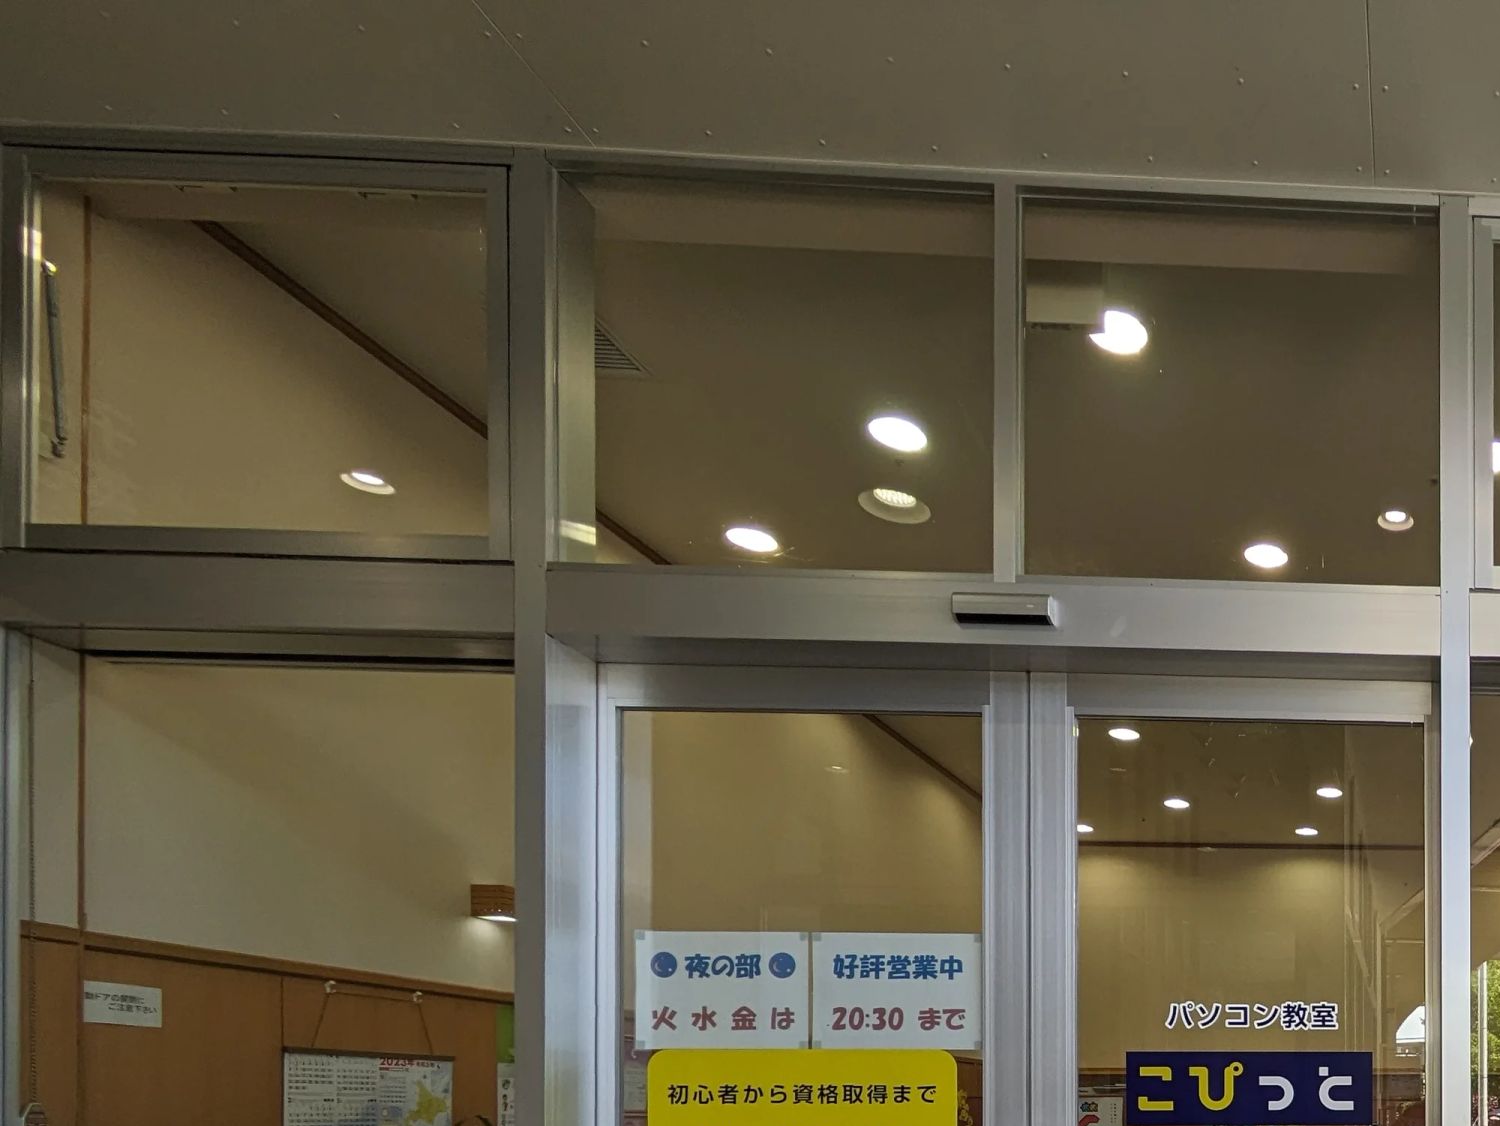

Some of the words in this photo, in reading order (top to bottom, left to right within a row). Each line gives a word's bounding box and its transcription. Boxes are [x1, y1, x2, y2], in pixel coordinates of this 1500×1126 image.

[684, 953, 763, 980] 夜の部
[832, 953, 964, 980] 好評営業中
[831, 1006, 904, 1031] 20:30
[918, 1007, 967, 1031] まで
[1165, 1002, 1339, 1031] パソコン教室
[667, 1083, 938, 1105] 初心者から資格取得まで
[1137, 1061, 1355, 1112] こぴっと
